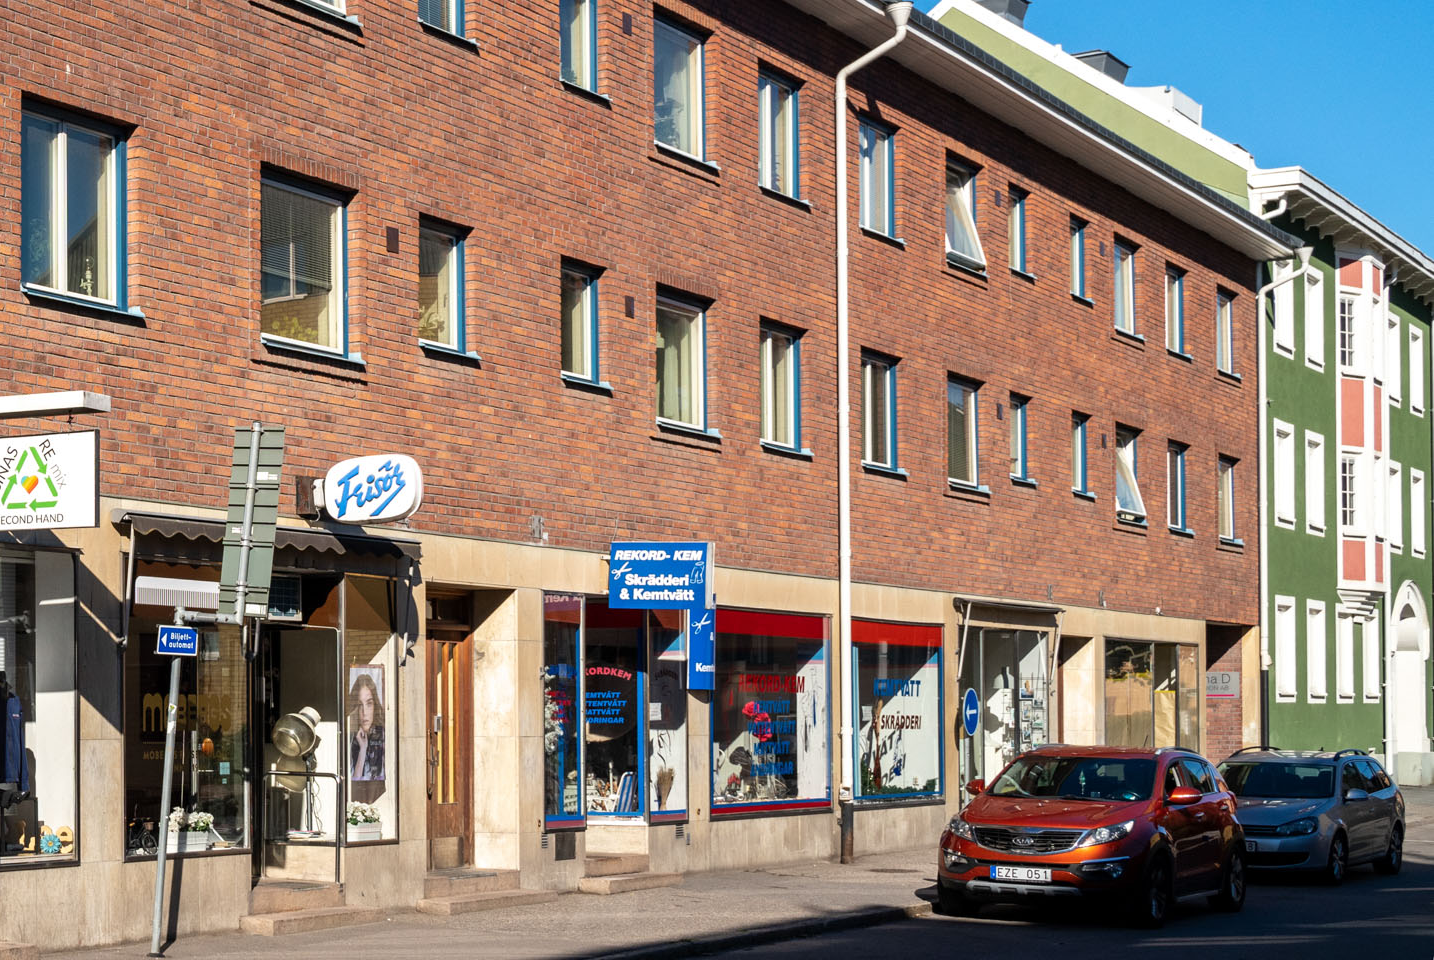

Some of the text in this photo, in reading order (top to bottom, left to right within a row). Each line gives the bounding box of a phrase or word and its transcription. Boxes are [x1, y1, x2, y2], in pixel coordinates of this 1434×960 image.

[39, 438, 67, 490] RE mix
[35, 513, 64, 523] HAND
[614, 550, 704, 561] REKORD- KEM
[624, 573, 689, 586] Skrädderi
[619, 588, 695, 601] & Kemtvätt
[170, 632, 192, 641] Biljett-
[168, 641, 194, 650] automat
[738, 674, 805, 693] REKORD-KEM
[1221, 673, 1231, 684] D
[873, 676, 921, 697] KEMTVÄTT
[880, 710, 922, 730] SKRÄDDERI
[997, 867, 1049, 880] EZE 051
